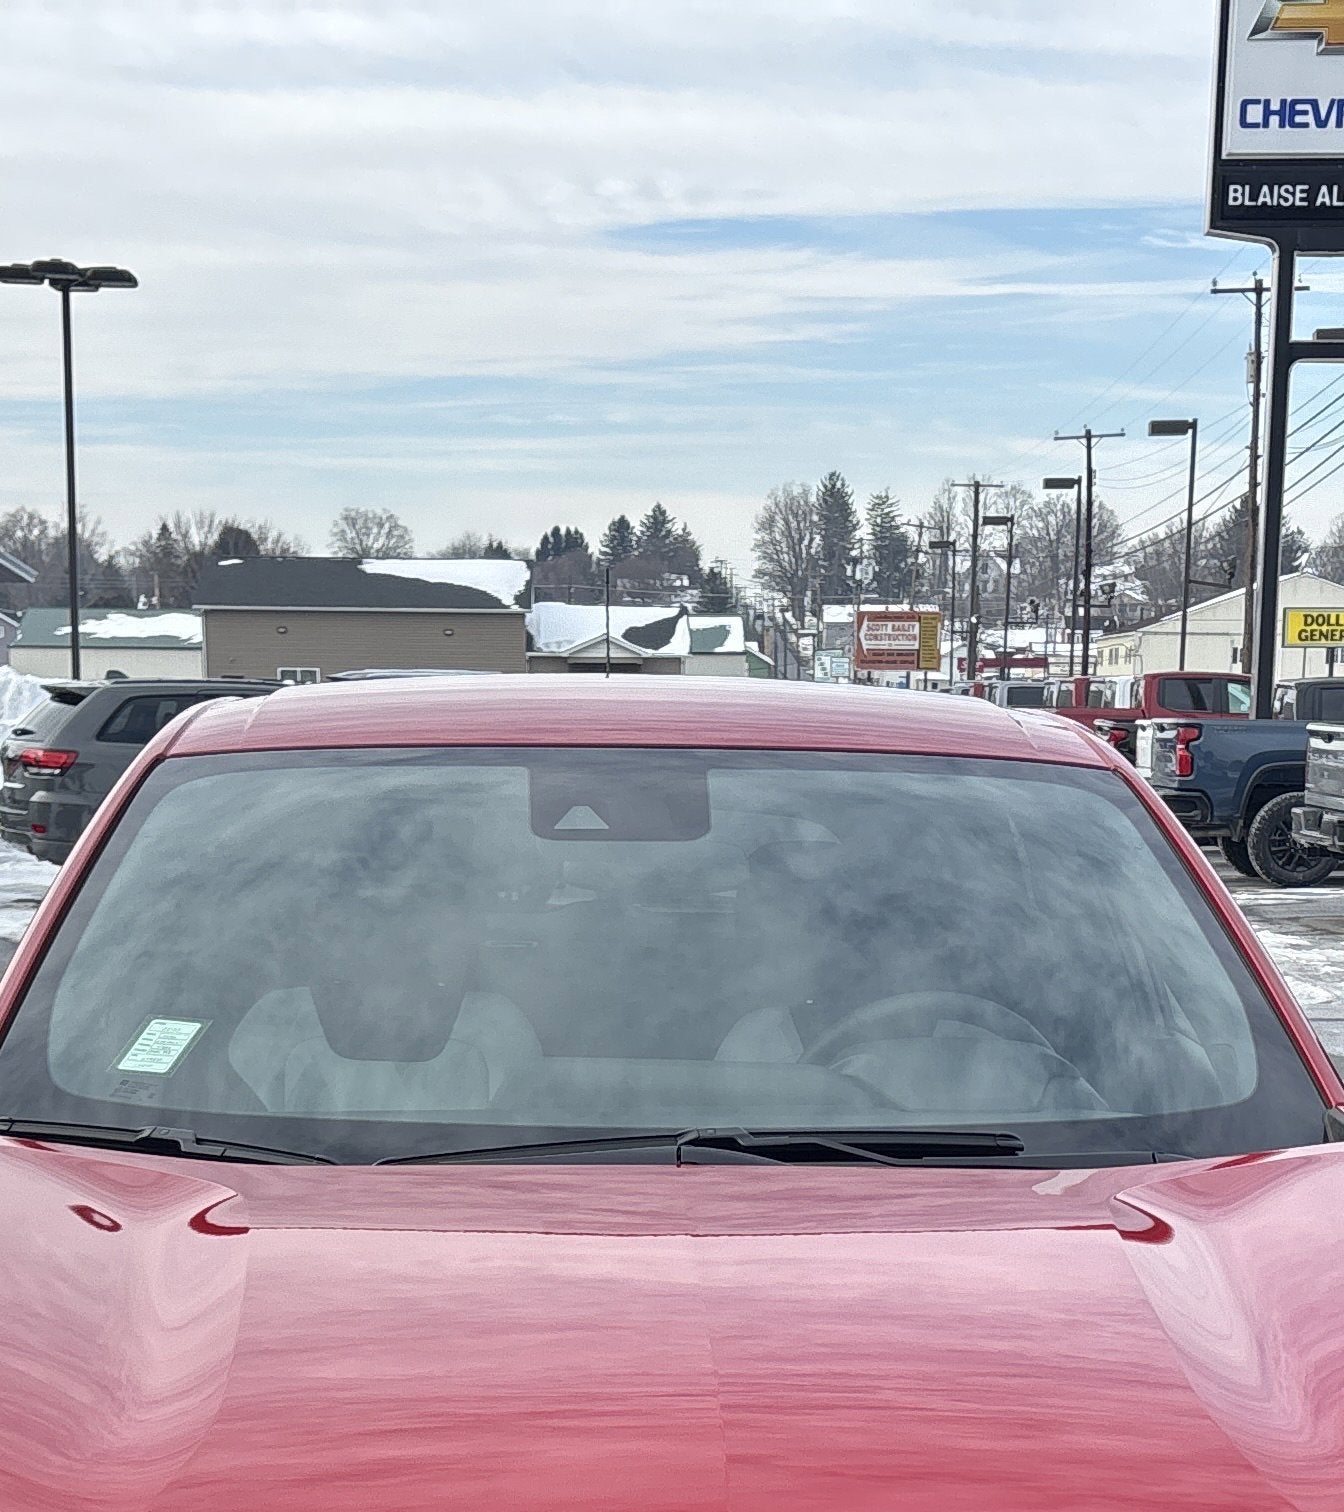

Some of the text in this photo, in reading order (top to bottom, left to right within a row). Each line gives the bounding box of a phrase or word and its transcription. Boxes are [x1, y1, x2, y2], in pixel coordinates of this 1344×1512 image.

[1228, 184, 1309, 206] BLAISE
[865, 623, 889, 632] SCOTT
[863, 633, 917, 642] CONSTRUCTION
